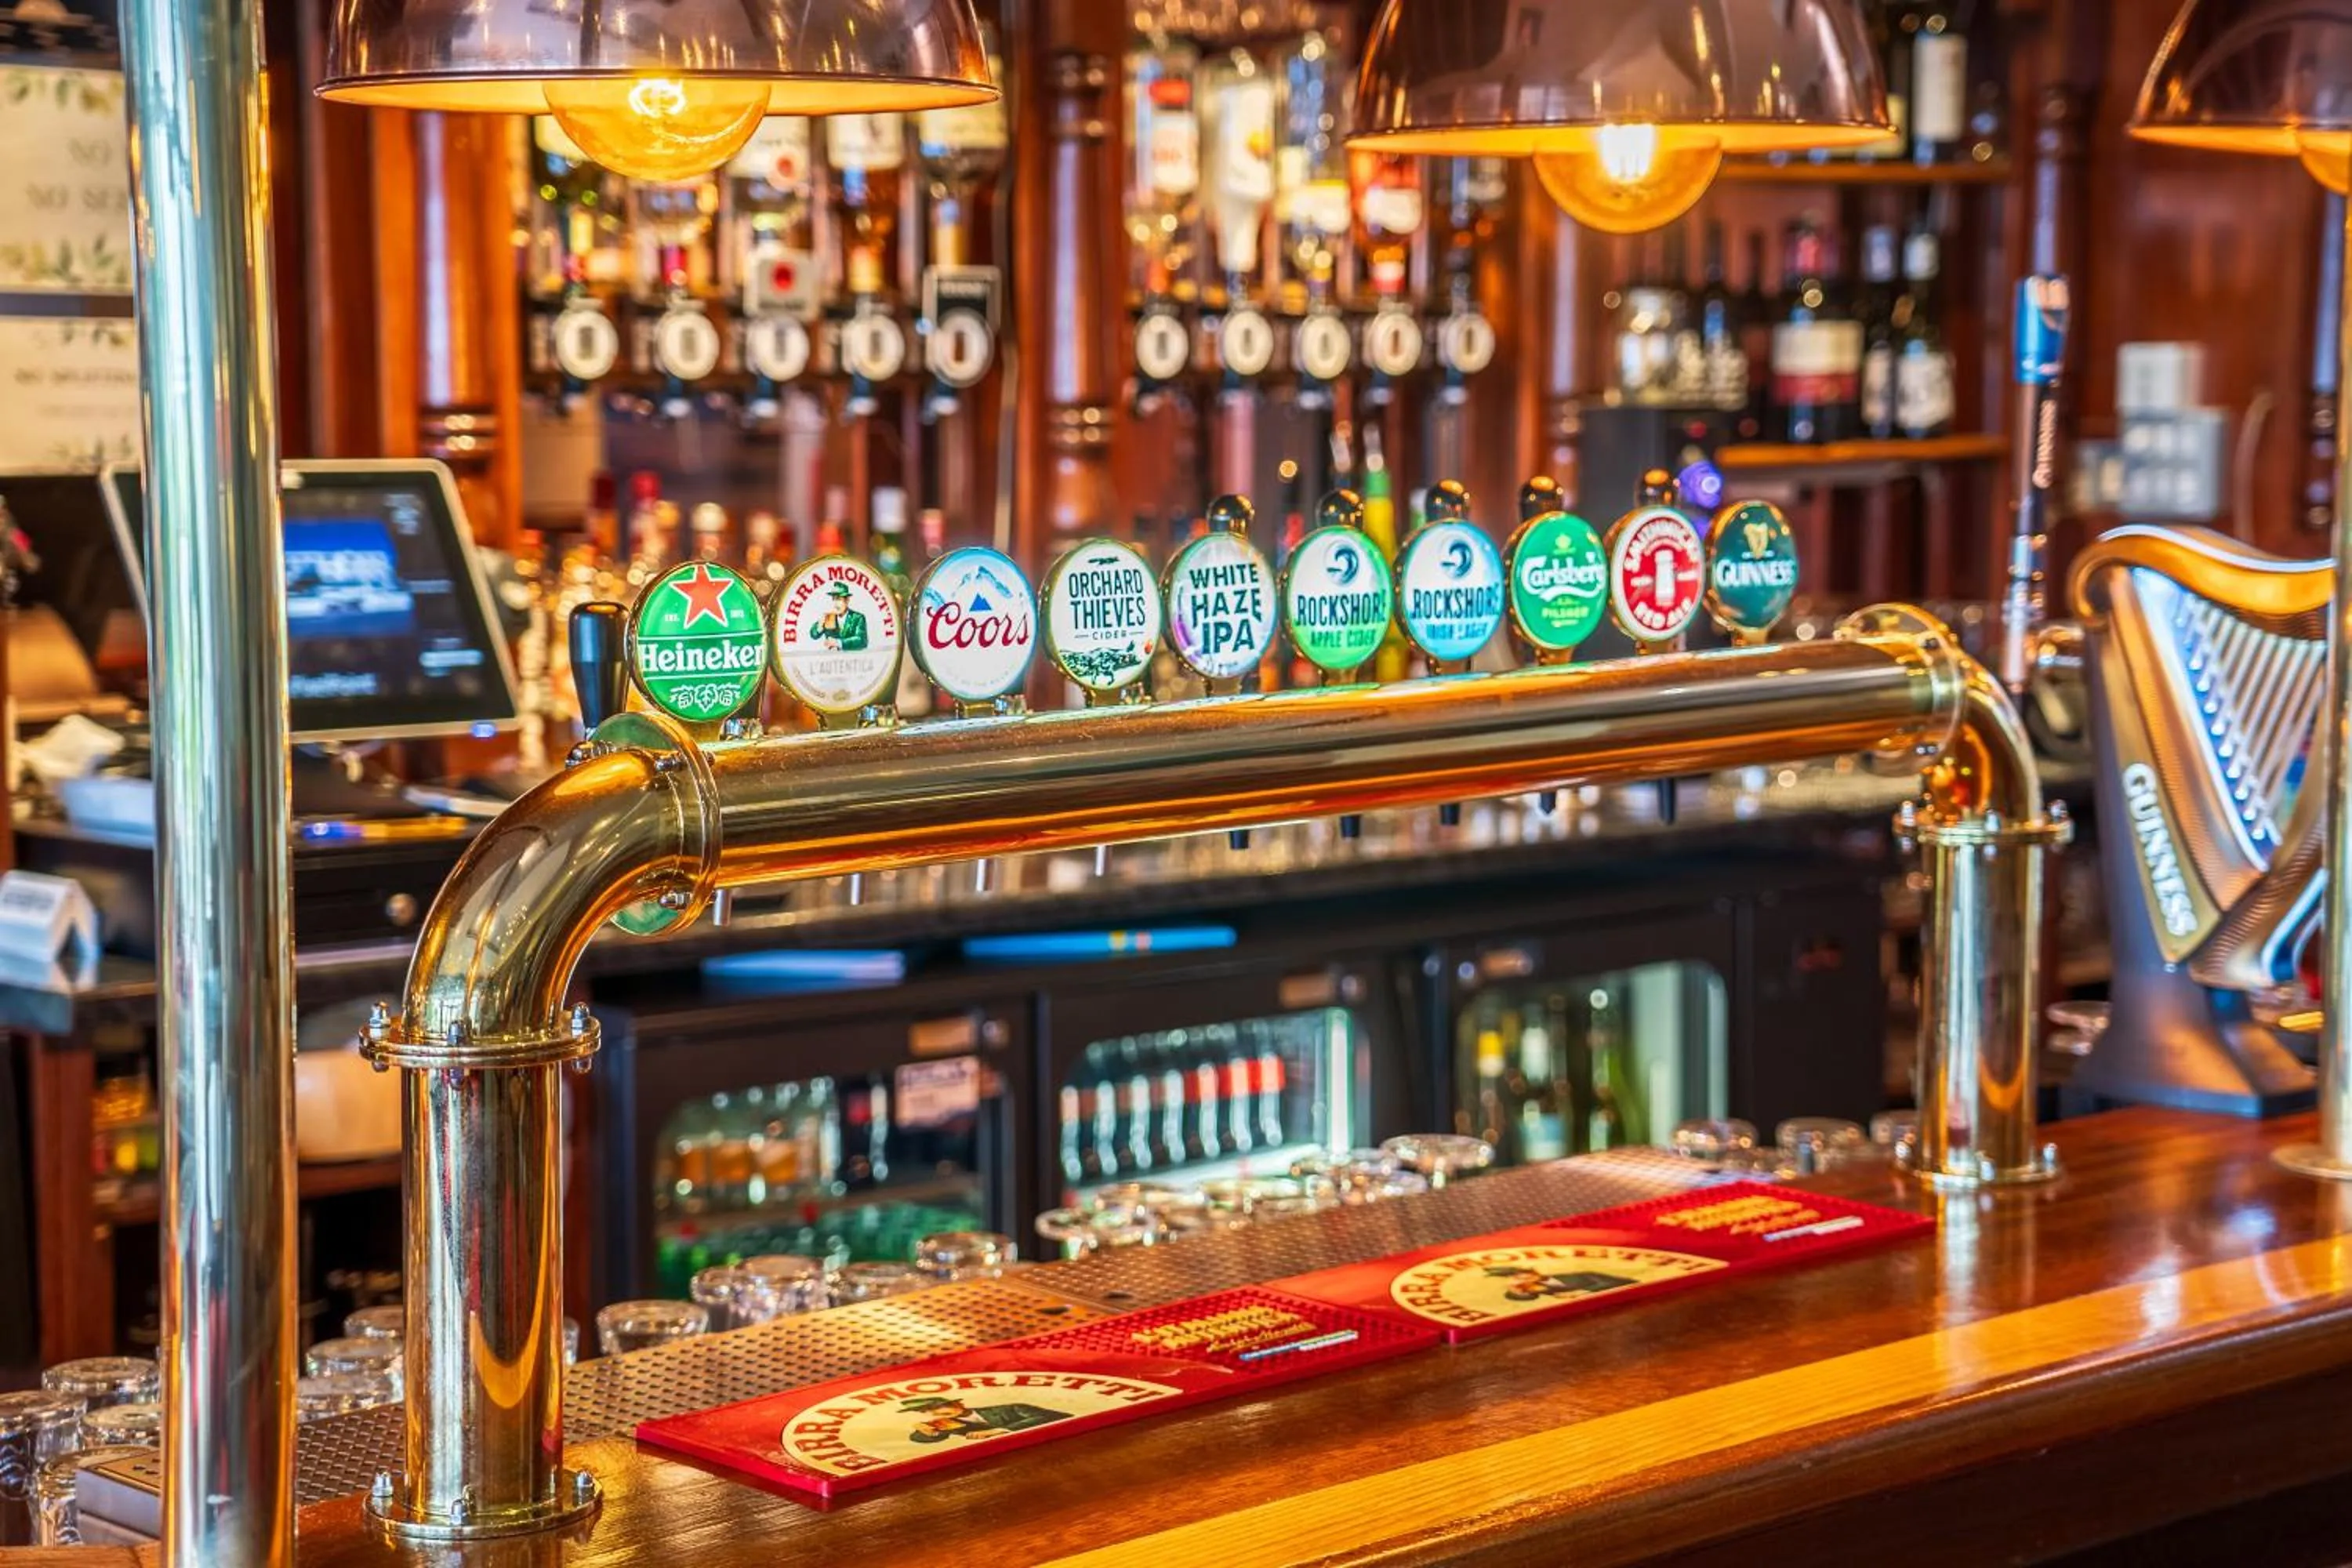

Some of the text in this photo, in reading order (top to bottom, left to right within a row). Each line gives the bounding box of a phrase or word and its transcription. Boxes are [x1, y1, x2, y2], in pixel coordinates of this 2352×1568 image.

[1069, 568, 1144, 598] ORCHARD
[1189, 564, 1260, 589] WHITE
[1521, 552, 1606, 601] Carlsberg
[1716, 559, 1795, 587] GUINNESS
[784, 566, 895, 643] BIRRA MORETTI
[1070, 597, 1145, 630] THIEVES
[1191, 588, 1262, 628] HAZE
[1296, 589, 1387, 626] ROCKSHORE
[1634, 601, 1666, 629] RED
[926, 601, 1029, 649] Coors
[1092, 631, 1127, 640] CIDER
[1201, 619, 1255, 655] IPA
[1311, 630, 1342, 648] APPLE
[2122, 763, 2198, 936] GUINNESS
[1400, 1249, 1711, 1323] BIRRA MORETTI
[794, 1374, 1167, 1471] BIRRA MORETTI
